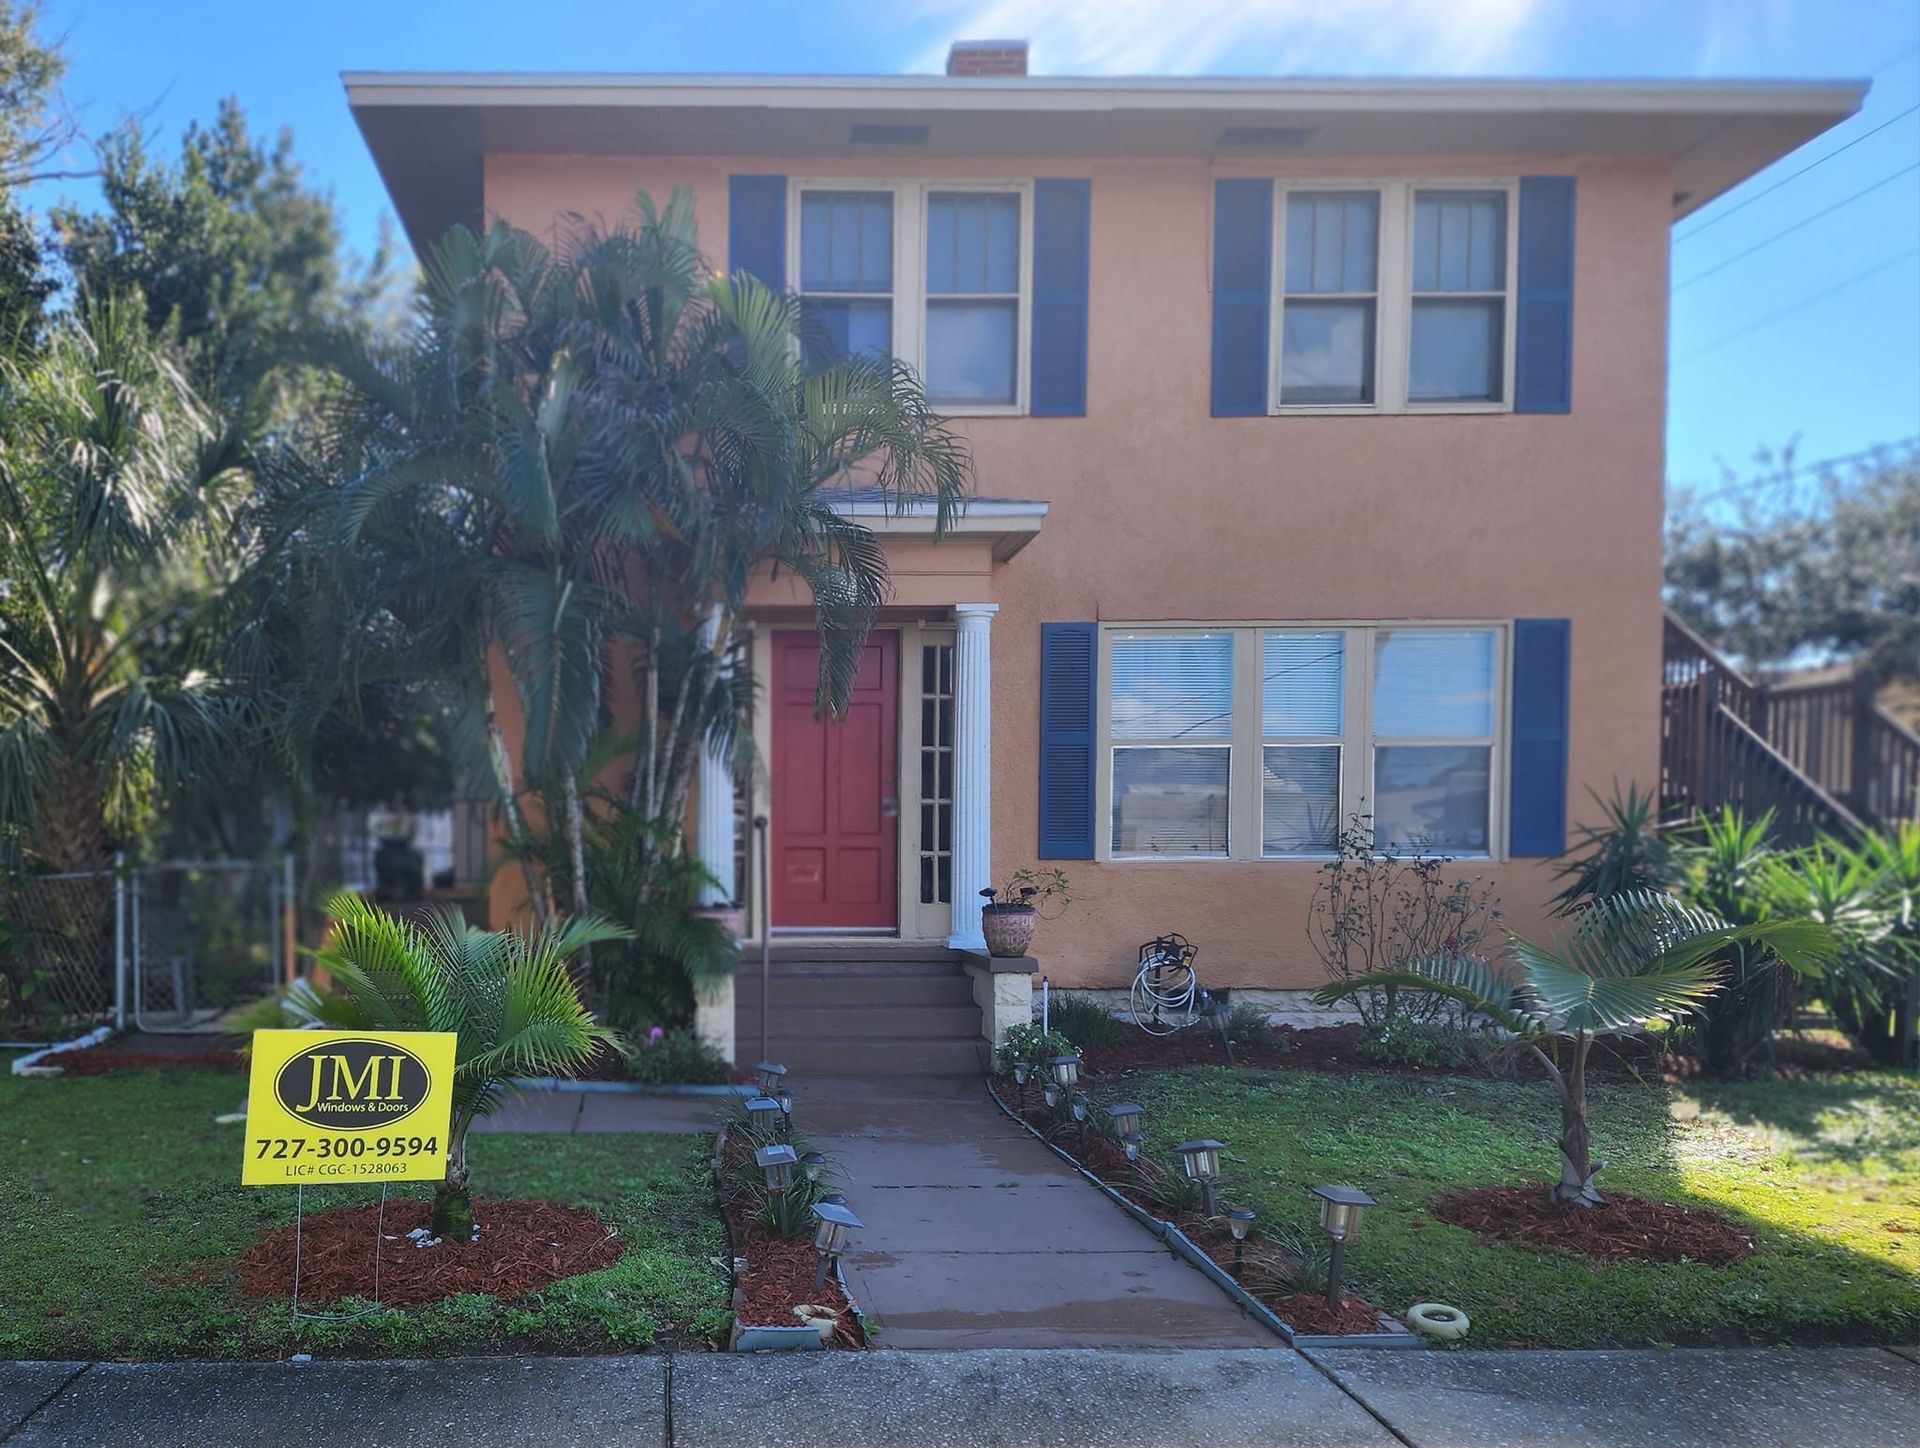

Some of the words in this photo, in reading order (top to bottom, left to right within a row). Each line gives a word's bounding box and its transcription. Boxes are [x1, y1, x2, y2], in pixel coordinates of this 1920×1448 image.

[295, 1055, 407, 1113] JMI
[317, 1102, 366, 1112] Windows
[367, 1102, 376, 1112] &
[378, 1102, 409, 1112] Doors
[256, 1136, 438, 1159] 727-300-9594
[286, 1164, 314, 1176] LIC#
[318, 1163, 407, 1176] CGC-1528063
